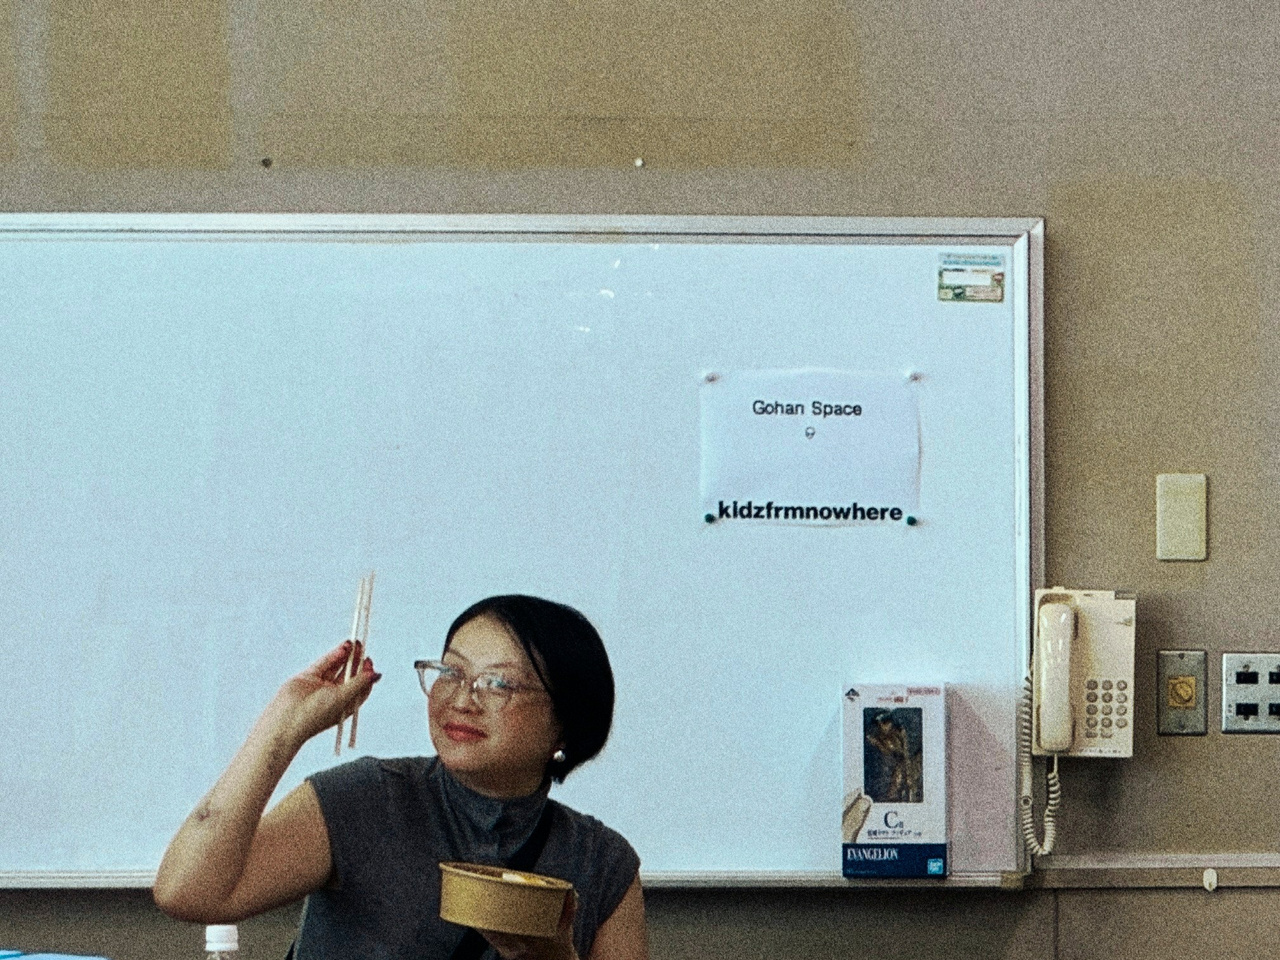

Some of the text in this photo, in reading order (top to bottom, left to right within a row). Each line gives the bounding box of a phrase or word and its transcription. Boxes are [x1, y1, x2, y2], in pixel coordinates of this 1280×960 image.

[752, 400, 862, 418] Gohan Space
[718, 501, 903, 521] kidzfrmnowhere
[847, 848, 899, 861] EVANGELION
